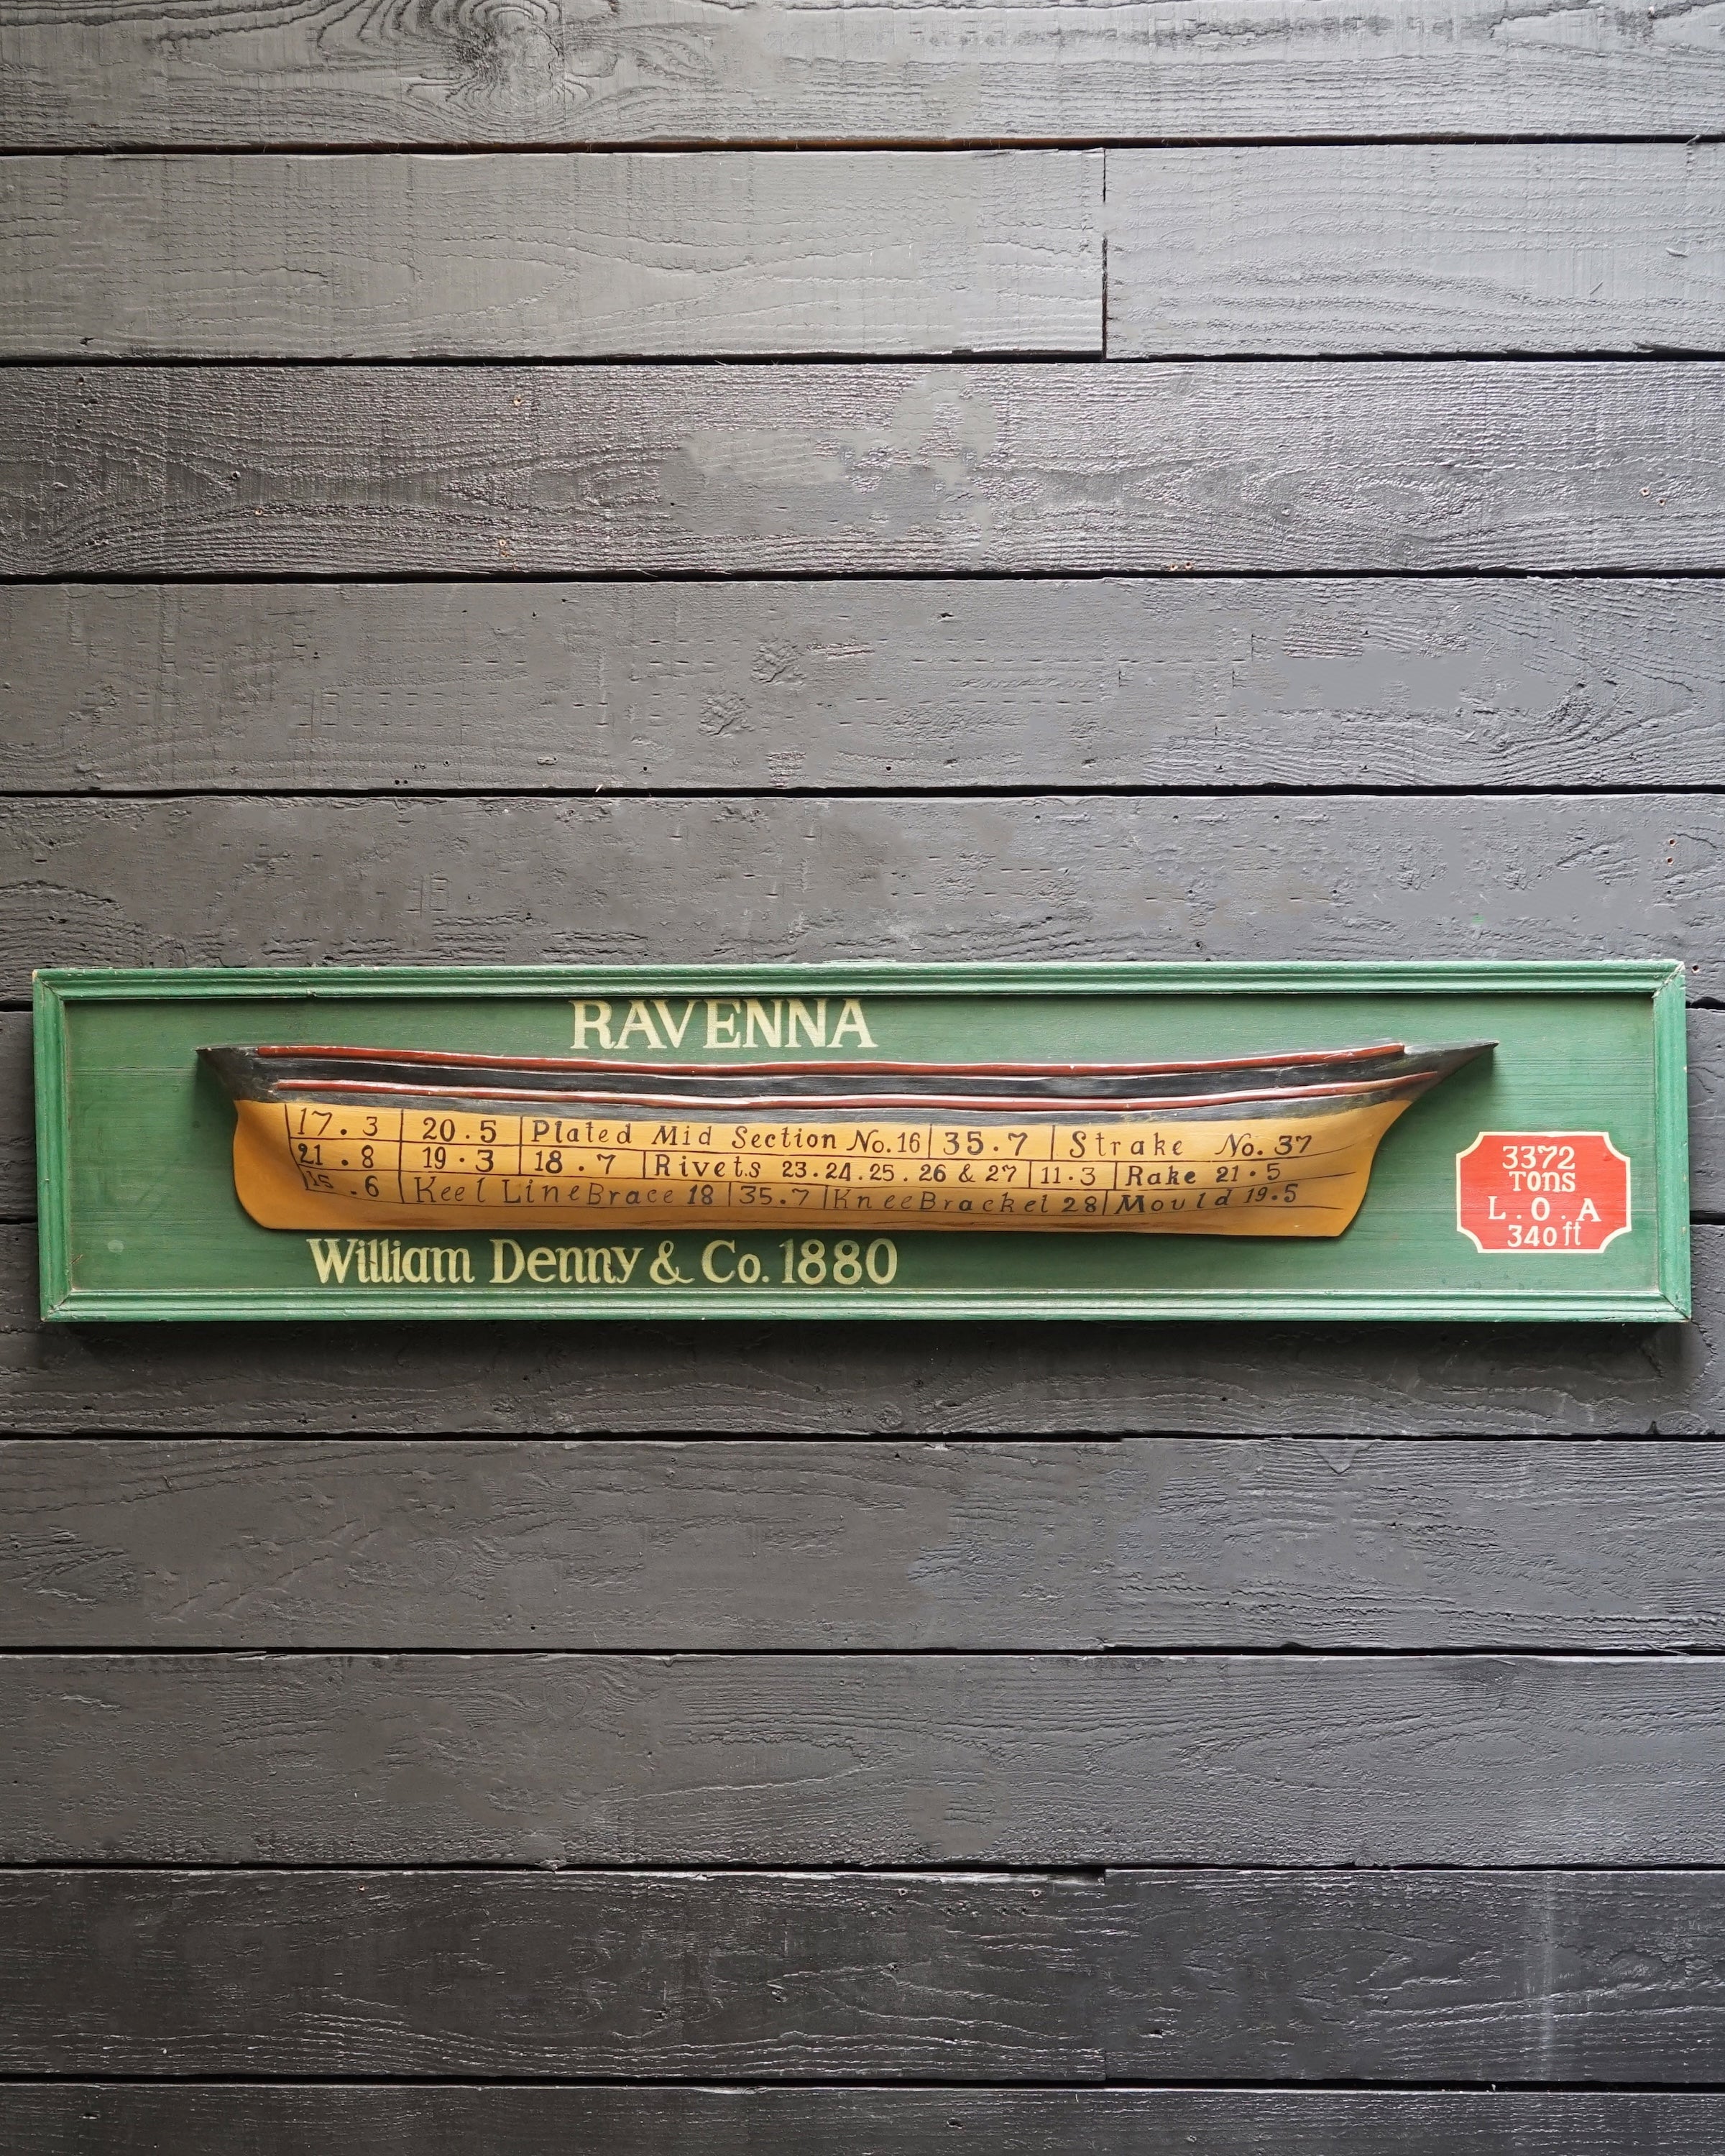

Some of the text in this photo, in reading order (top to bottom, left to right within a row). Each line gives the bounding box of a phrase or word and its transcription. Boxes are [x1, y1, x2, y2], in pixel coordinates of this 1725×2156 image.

[569, 998, 879, 1050] RAVENNA
[297, 1107, 378, 1137] 17.3
[423, 1117, 497, 1143] 20.5
[533, 1120, 632, 1144] Plated
[651, 1125, 712, 1146] Mid
[732, 1125, 837, 1150] Section
[298, 1144, 374, 1169] 21.8
[943, 1131, 1028, 1156] 35.7
[1069, 1130, 1312, 1158] Strake No. 37
[423, 1146, 495, 1173] 19.3
[534, 1150, 616, 1174] 18.7
[655, 1153, 762, 1179] Rivets
[957, 1164, 975, 1183] &
[985, 1164, 1017, 1182] 27
[1502, 1146, 1576, 1169] 3372
[1039, 1166, 1097, 1186] 11.3
[1125, 1162, 1281, 1187] Rake 21.5
[415, 1176, 487, 1204] Keel
[686, 1184, 714, 1205] 18
[740, 1185, 810, 1206] 35.7
[1114, 1183, 1300, 1215] Mould 19.5
[1061, 1196, 1097, 1215] 28
[306, 1238, 899, 1285] William Denny & Co. 1880
